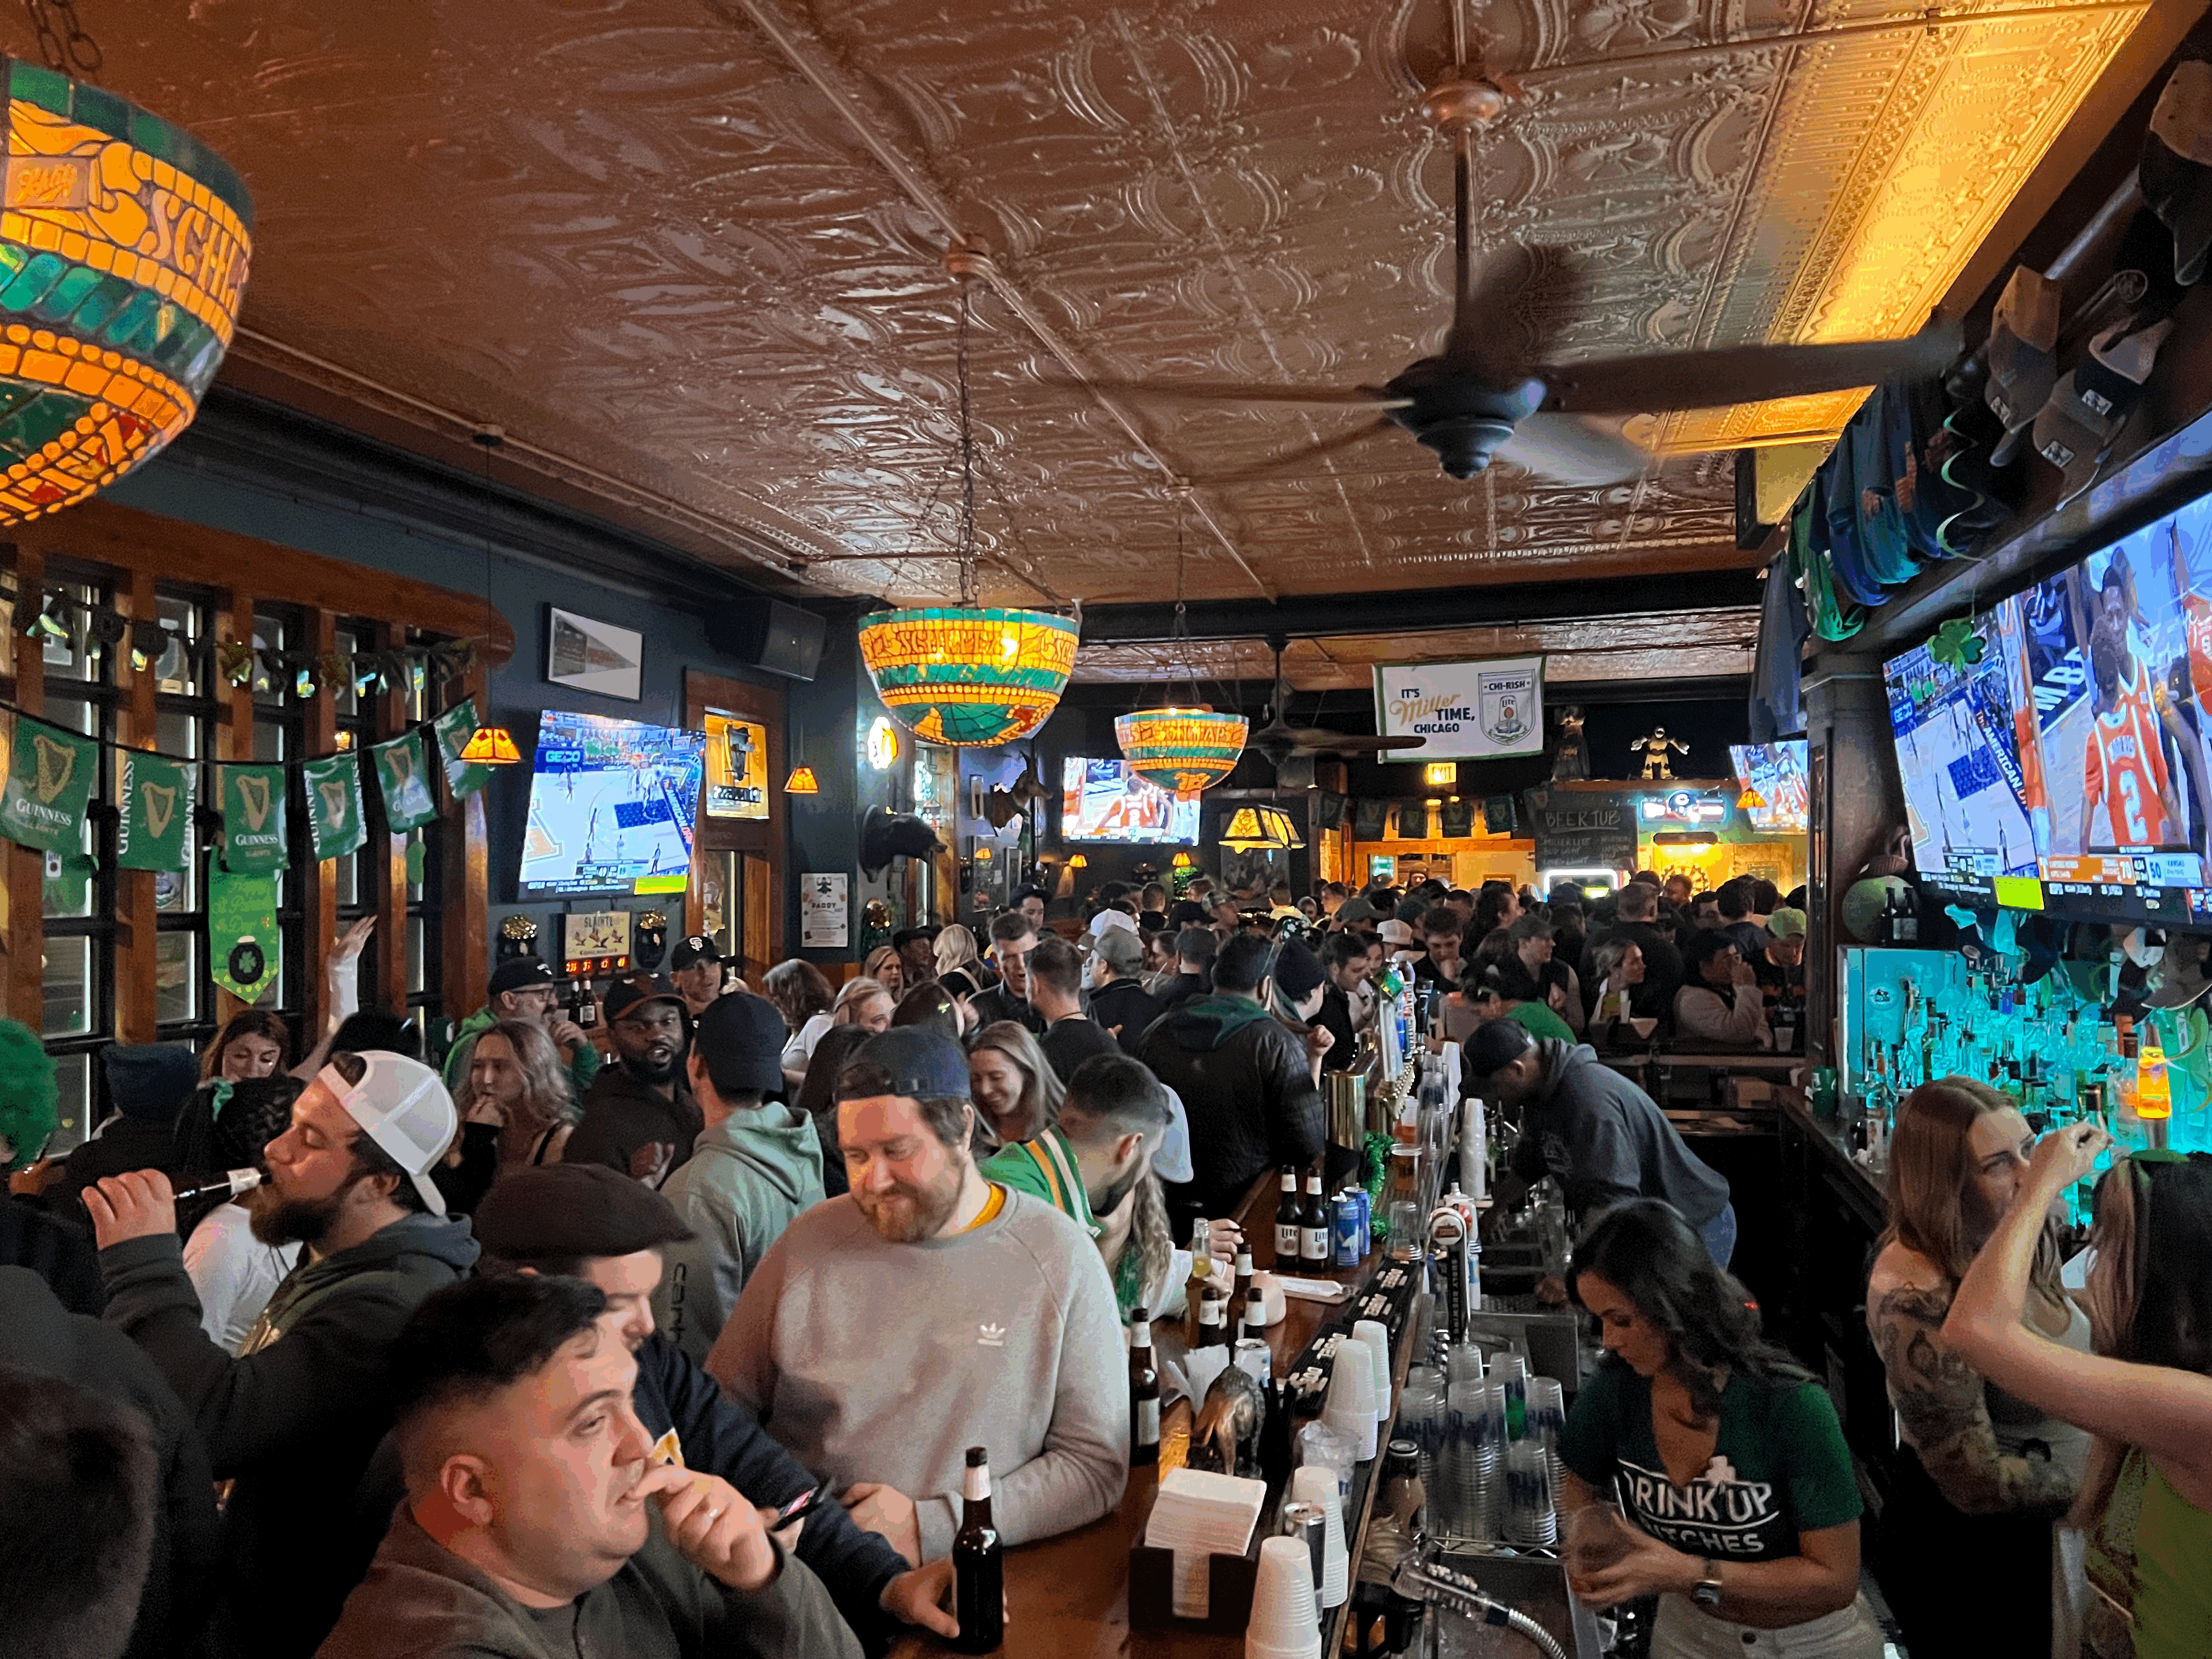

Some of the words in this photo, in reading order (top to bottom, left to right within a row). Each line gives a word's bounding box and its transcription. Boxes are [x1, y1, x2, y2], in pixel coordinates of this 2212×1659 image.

[1488, 680, 1526, 691] CHI-RISH
[1401, 689, 1420, 698] IT'S
[1389, 693, 1462, 726] Miller
[1436, 707, 1476, 721] TIME,
[1414, 723, 1460, 733] CHICAGO
[545, 750, 580, 763] GECO
[16, 798, 72, 827] GUINNESS
[119, 760, 136, 854] GUINNESS
[2119, 769, 2148, 843] 2
[1545, 811, 1587, 827] BEER
[1592, 810, 1621, 827] TUB
[235, 833, 279, 846] GUINNESS
[1727, 1482, 1773, 1523] UP
